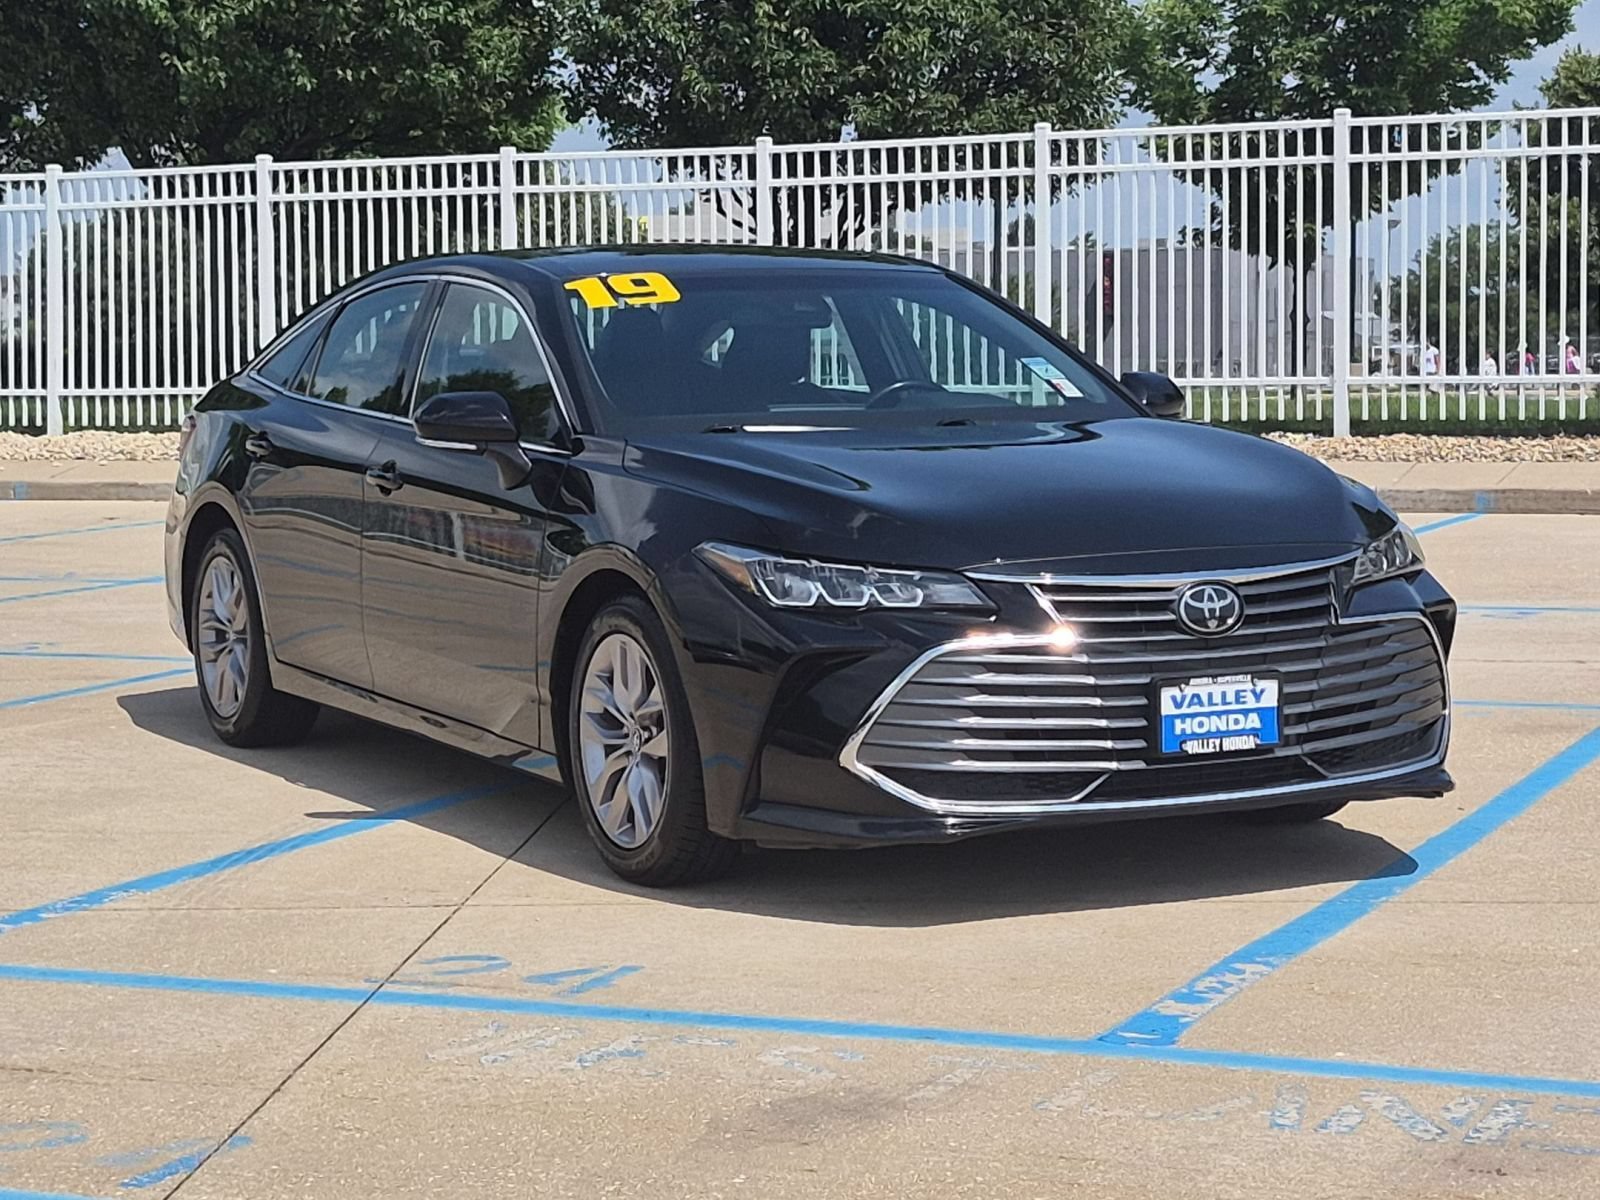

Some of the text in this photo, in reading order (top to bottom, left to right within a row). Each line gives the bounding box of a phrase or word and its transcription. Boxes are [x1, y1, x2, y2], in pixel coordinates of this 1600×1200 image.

[563, 272, 681, 309] 19
[1170, 687, 1266, 710] VALLEY
[1174, 712, 1262, 735] HONDA
[1187, 735, 1256, 755] VALLEY HONDA
